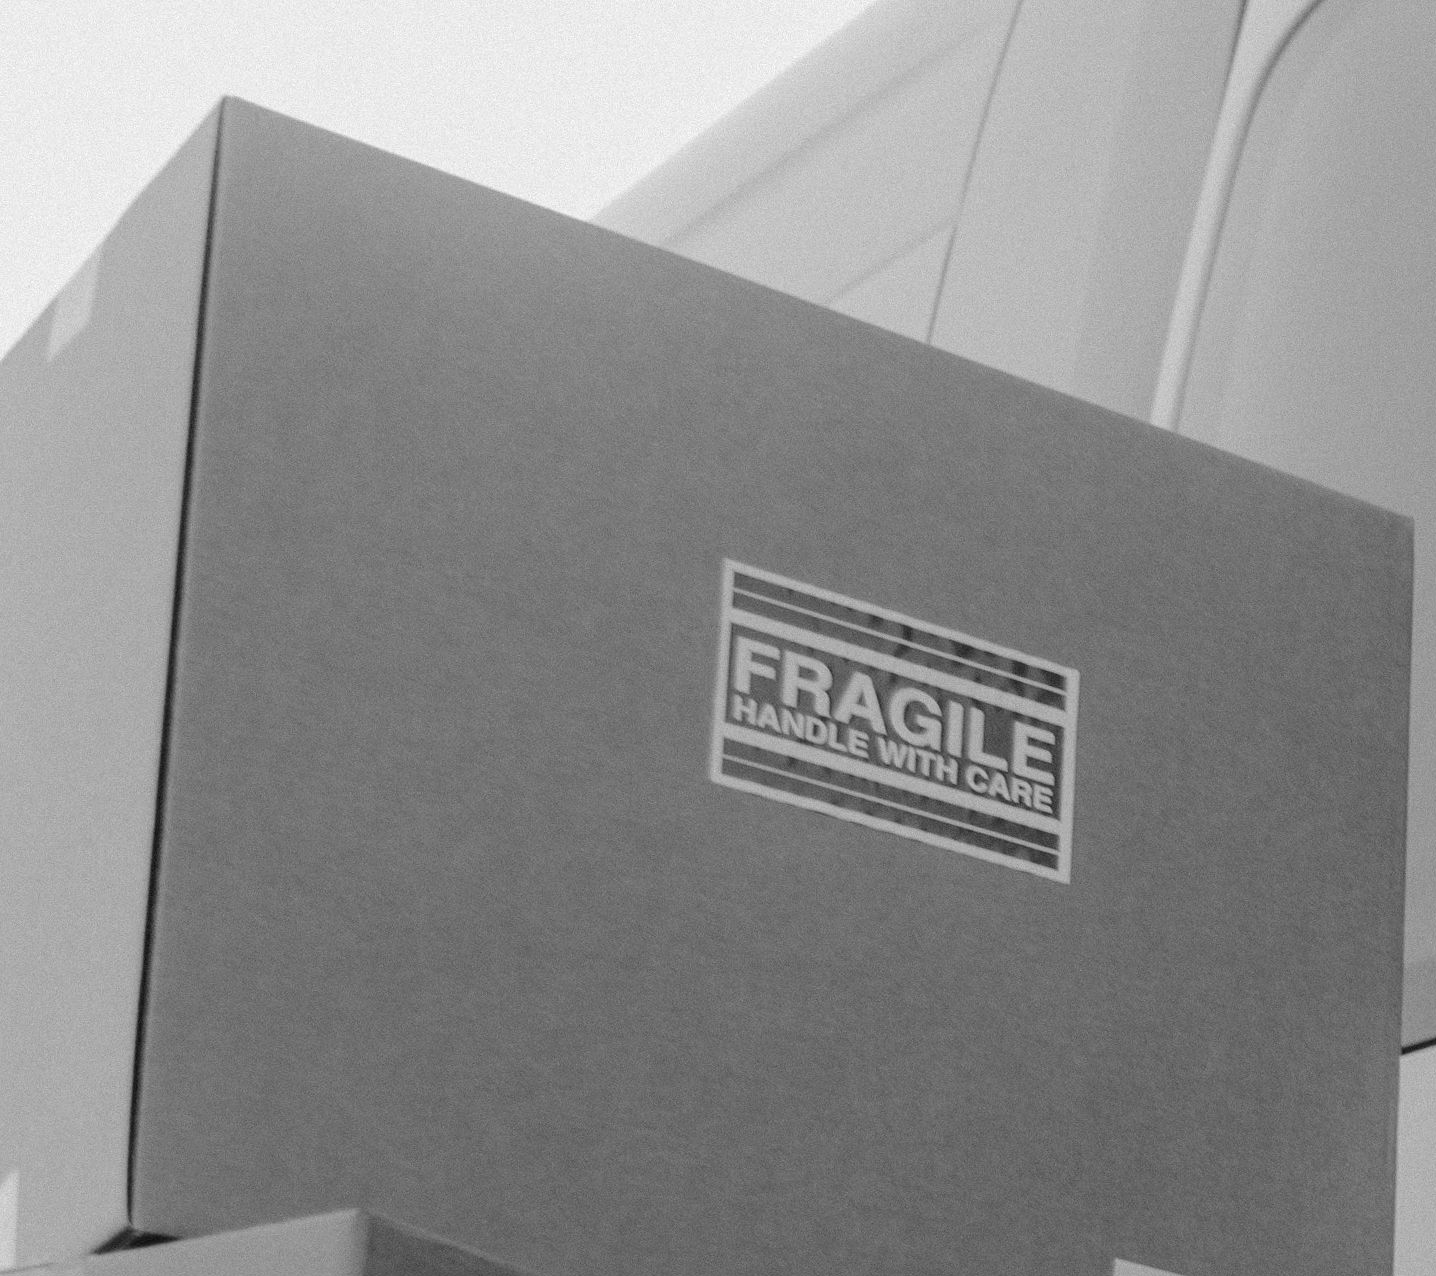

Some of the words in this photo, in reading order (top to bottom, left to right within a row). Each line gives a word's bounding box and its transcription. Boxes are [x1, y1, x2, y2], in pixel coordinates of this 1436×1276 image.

[733, 694, 870, 759] HANDLE
[877, 735, 958, 785] WITH
[965, 766, 1054, 815] CARE
[734, 635, 1056, 786] FRAGILE
